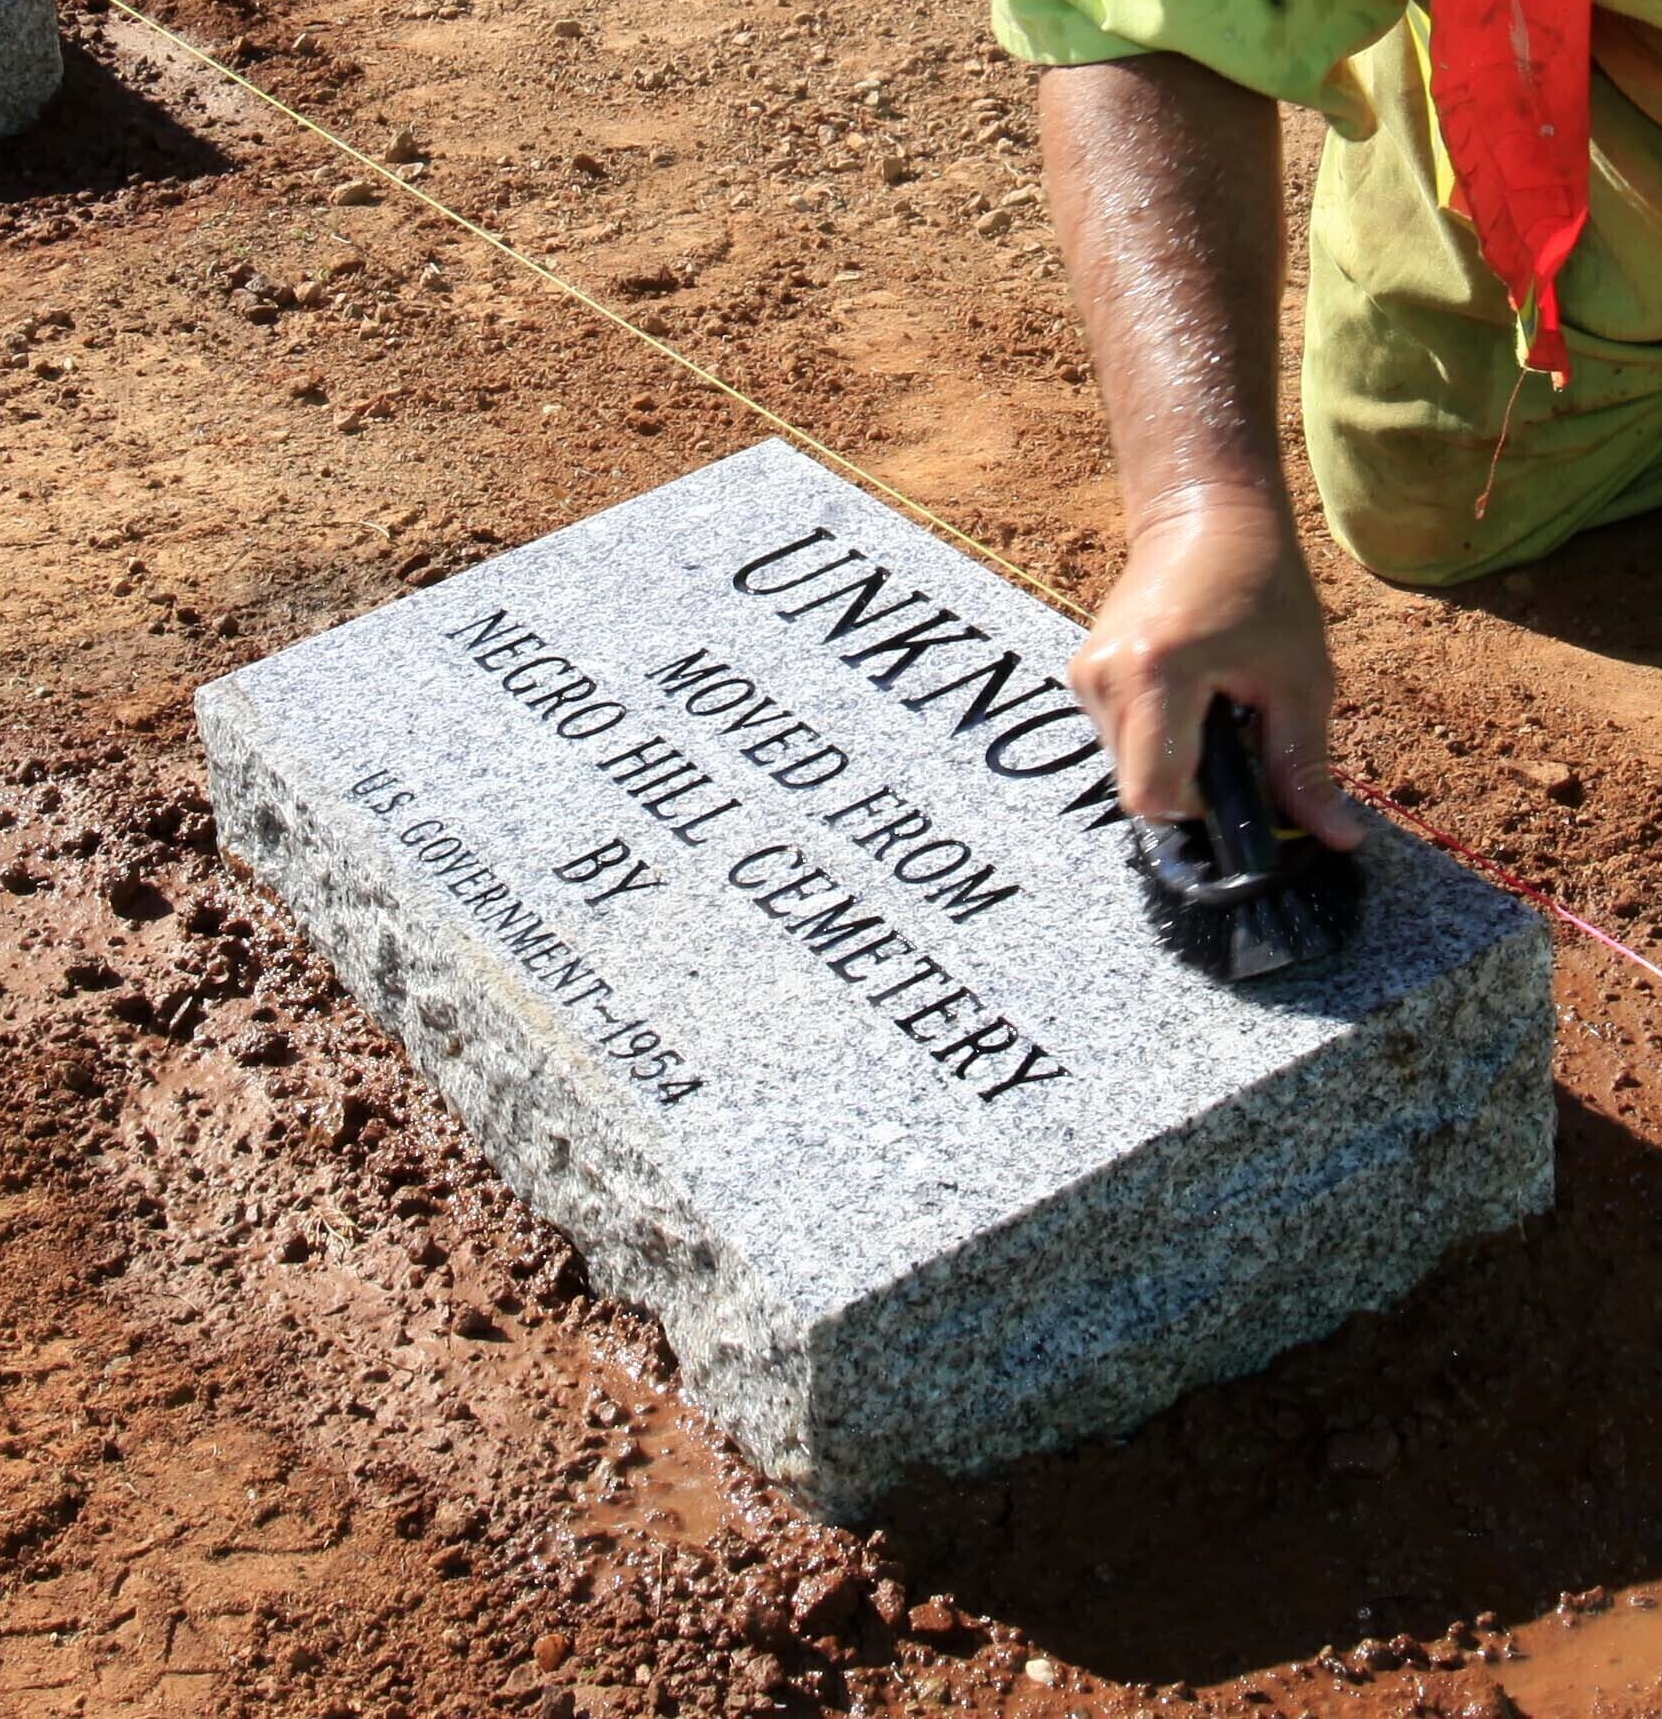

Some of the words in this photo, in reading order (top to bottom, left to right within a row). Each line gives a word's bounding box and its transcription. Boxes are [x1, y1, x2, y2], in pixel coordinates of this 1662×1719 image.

[444, 609, 627, 739] NEGRO
[595, 735, 742, 847] HILL
[728, 844, 1073, 1104] CEMETERY
[552, 837, 669, 908] BY
[643, 647, 849, 790] MOVED
[823, 786, 1026, 924] FROM
